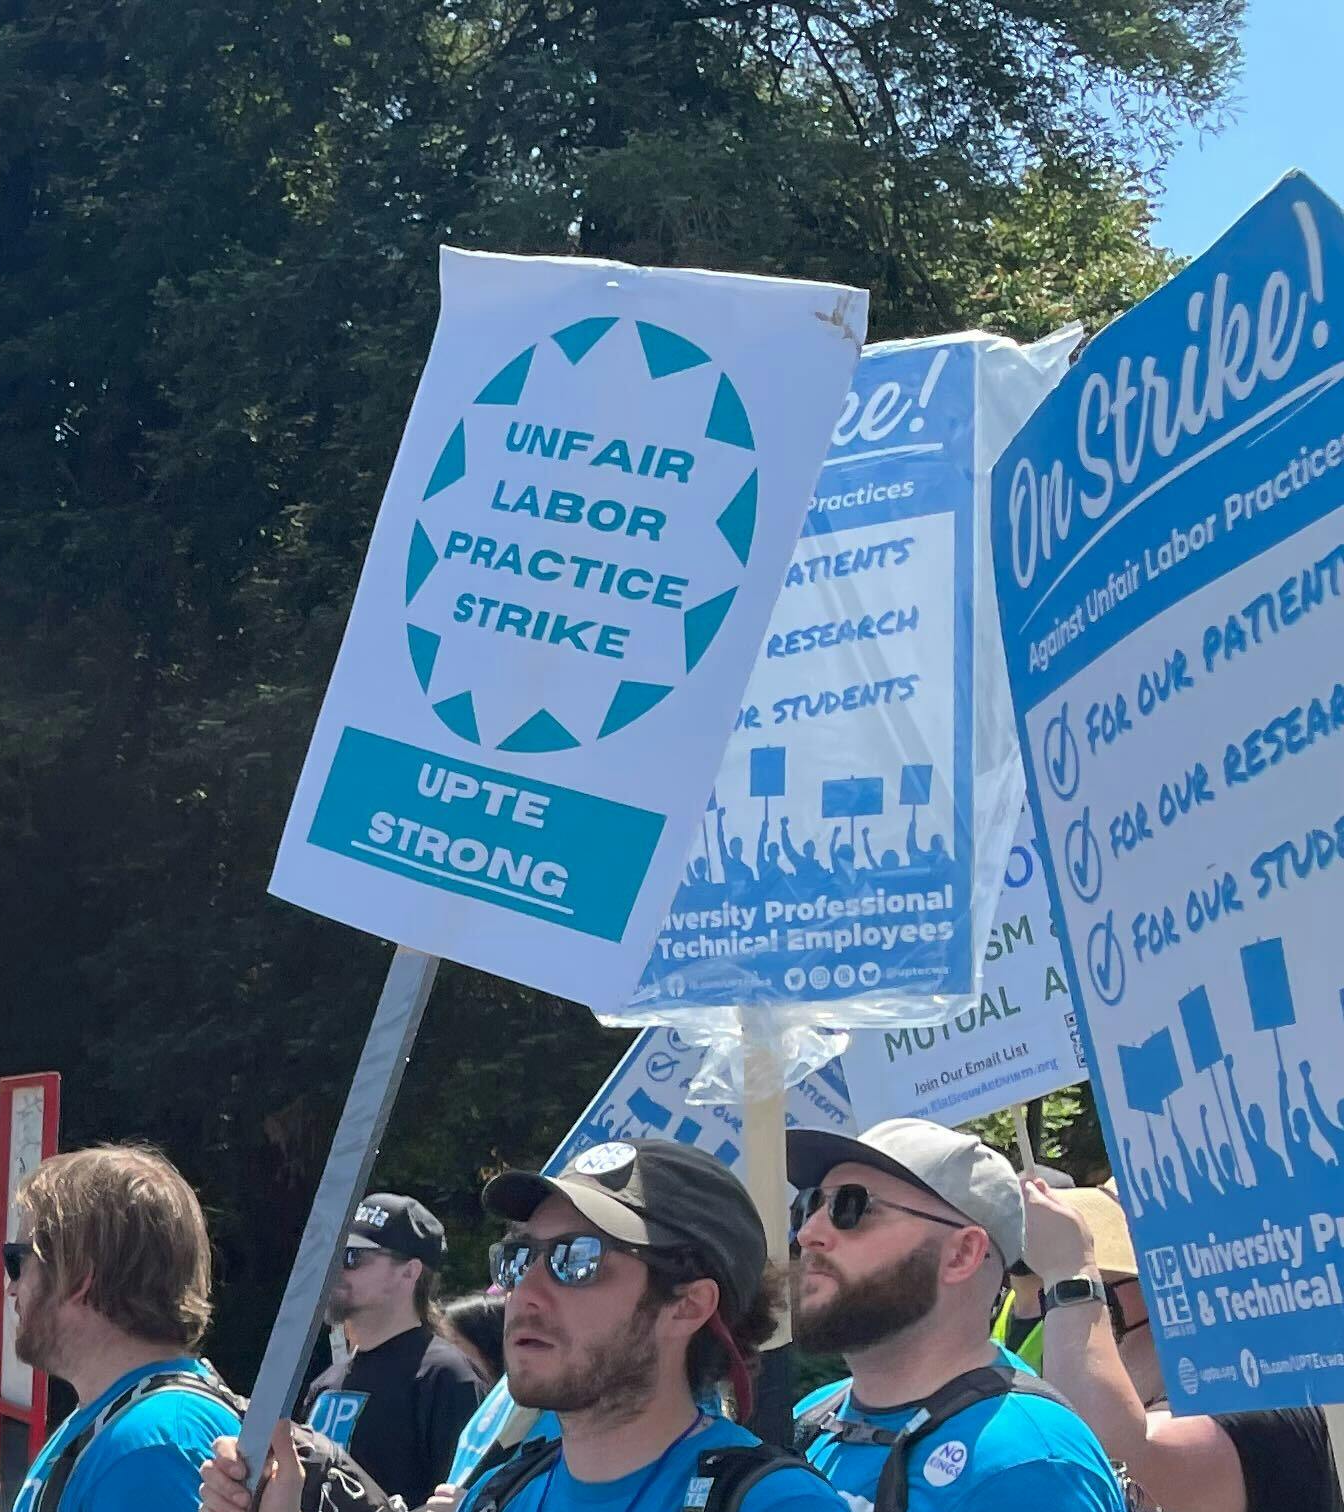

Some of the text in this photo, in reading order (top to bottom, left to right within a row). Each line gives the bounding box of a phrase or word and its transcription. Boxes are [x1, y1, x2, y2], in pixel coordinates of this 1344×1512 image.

[1008, 200, 1330, 590] On Strike!
[505, 420, 697, 485] UNFAIR
[491, 478, 668, 542] LABOR
[443, 532, 691, 611] PRACTICE
[784, 536, 916, 589] ATIENTS
[1028, 606, 1086, 676] Against
[1085, 558, 1141, 624] Unfair
[1142, 512, 1218, 582] Labor
[451, 592, 632, 661] STRIKE
[766, 604, 919, 660] RESEARCH
[1084, 543, 1344, 755] FOR OUR PATIENT
[772, 673, 922, 726] STUDENTS
[416, 763, 551, 829] UPTE
[1108, 683, 1344, 859] FOR OUR RESEAR
[367, 811, 570, 900] STRONG
[764, 884, 954, 925] Professional
[1131, 905, 1181, 963] FOR
[1185, 871, 1244, 934] OUR
[658, 929, 779, 961] Technical
[786, 919, 954, 955] Employees
[884, 985, 1022, 1064] MUTUAL
[914, 1042, 1030, 1097] Join Our Email List
[1182, 1219, 1303, 1279] University
[1196, 1262, 1343, 1327] & Technical
[939, 1443, 965, 1463] NO
